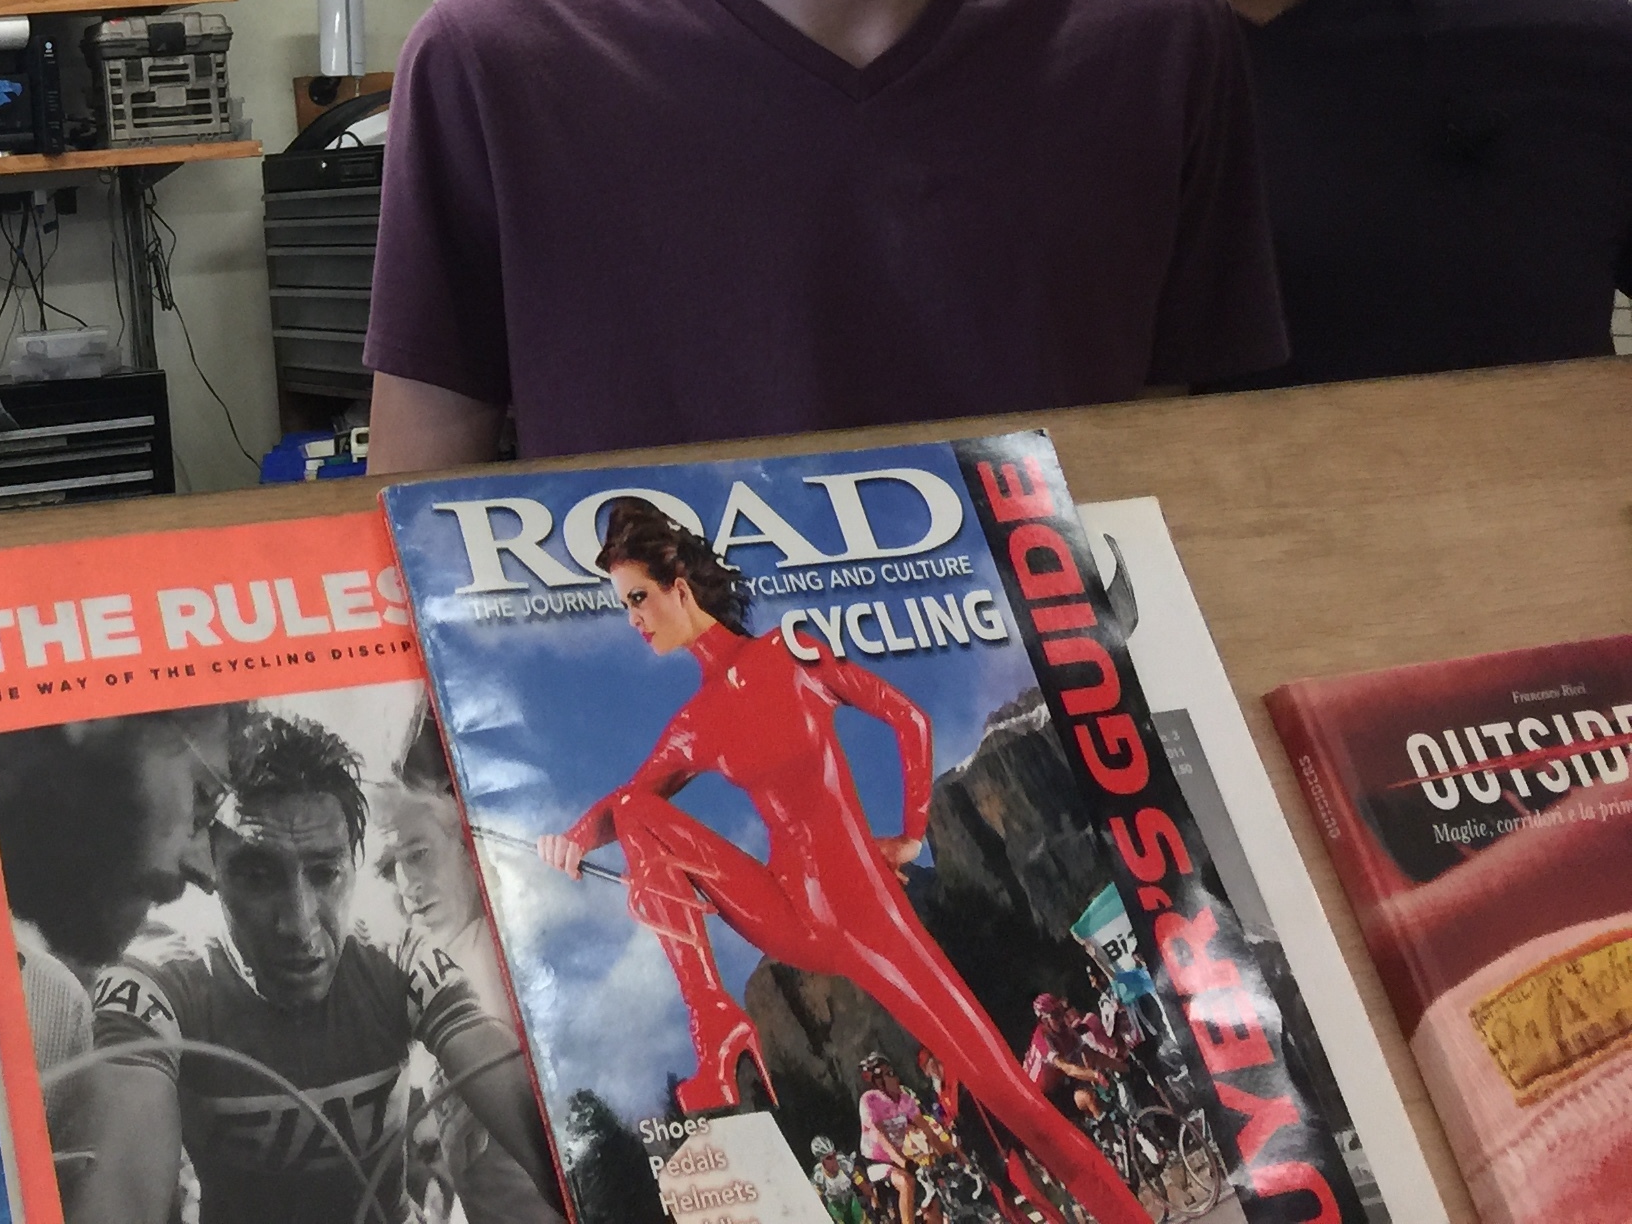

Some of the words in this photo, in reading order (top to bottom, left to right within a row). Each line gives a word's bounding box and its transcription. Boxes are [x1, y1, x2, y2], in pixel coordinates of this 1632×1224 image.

[432, 467, 963, 595] ROAD
[830, 566, 876, 589] AND
[880, 555, 974, 583] CULTURE
[470, 592, 515, 621] THE
[780, 589, 1009, 662] CYCLING
[978, 457, 1152, 795] GUIDE
[36, 678, 87, 695] WAY
[104, 671, 135, 687] OF
[150, 663, 197, 681] THE
[211, 649, 318, 675] CYCLING
[1298, 754, 1342, 840] OUTSIDERS
[1432, 817, 1494, 844] Maglie,
[1497, 805, 1563, 834] corridori
[1580, 801, 1597, 821] la
[639, 1116, 710, 1144] Shoes
[648, 1143, 729, 1180] Pedals
[659, 1181, 759, 1216] Helmets
